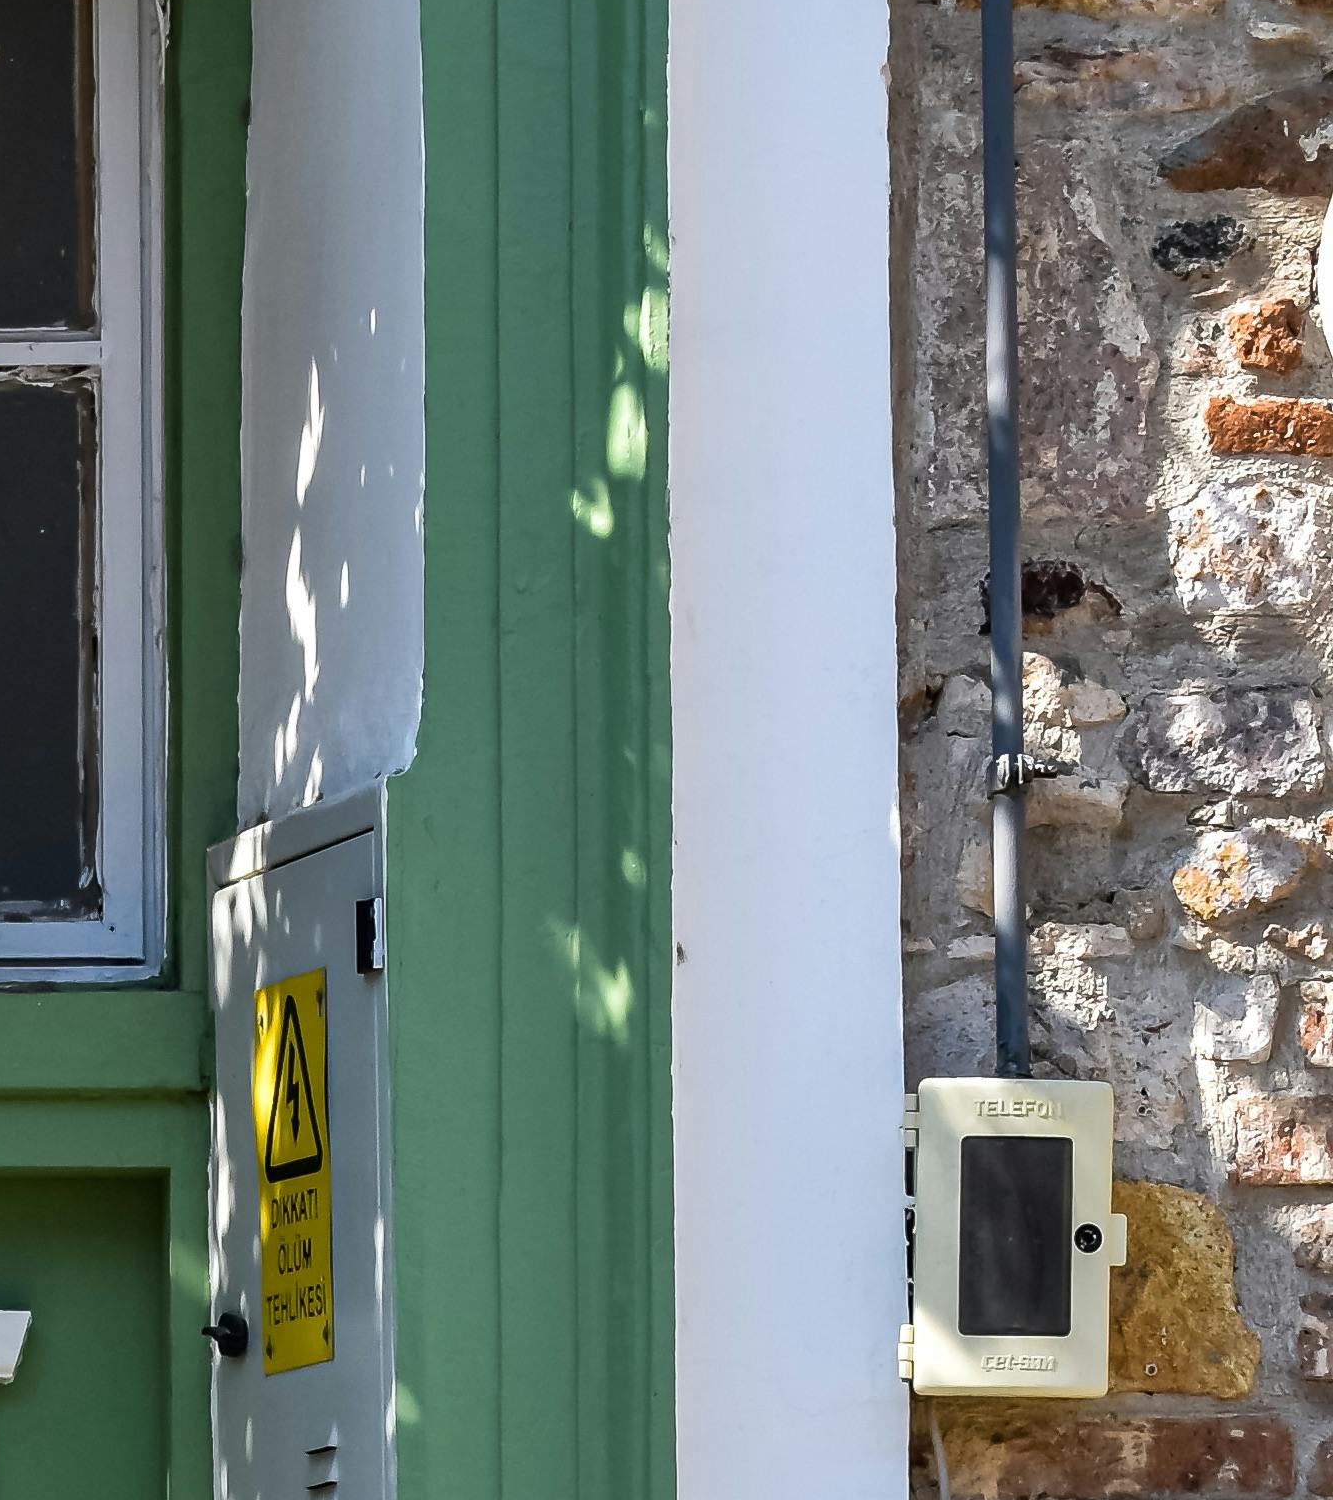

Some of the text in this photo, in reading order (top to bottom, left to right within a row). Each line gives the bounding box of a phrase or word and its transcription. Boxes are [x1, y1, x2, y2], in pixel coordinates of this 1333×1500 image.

[974, 1100, 1064, 1120] TELEFON
[277, 1235, 312, 1275] ÖLÜM
[266, 1277, 327, 1326] TEHLİKESİ
